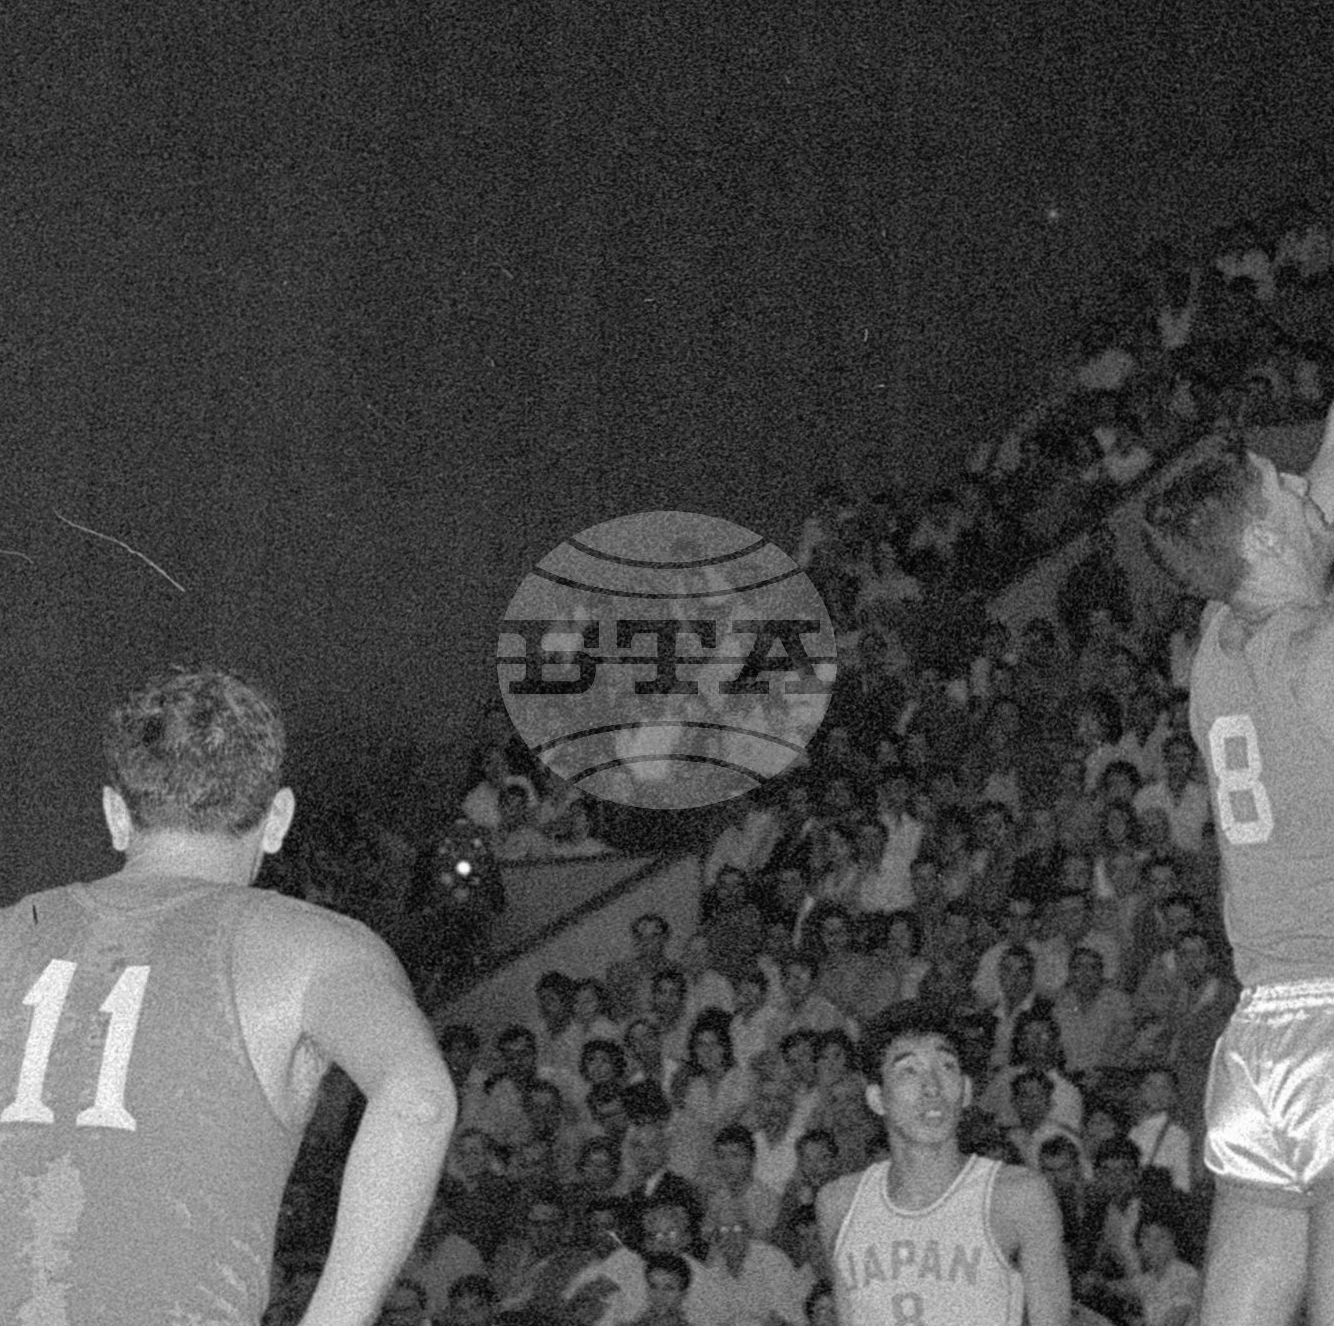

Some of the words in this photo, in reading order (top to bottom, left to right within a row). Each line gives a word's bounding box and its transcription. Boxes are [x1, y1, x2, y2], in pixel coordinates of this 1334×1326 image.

[1208, 714, 1274, 844] 8
[0, 958, 151, 1132] 11
[843, 1238, 984, 1291] JAPAN
